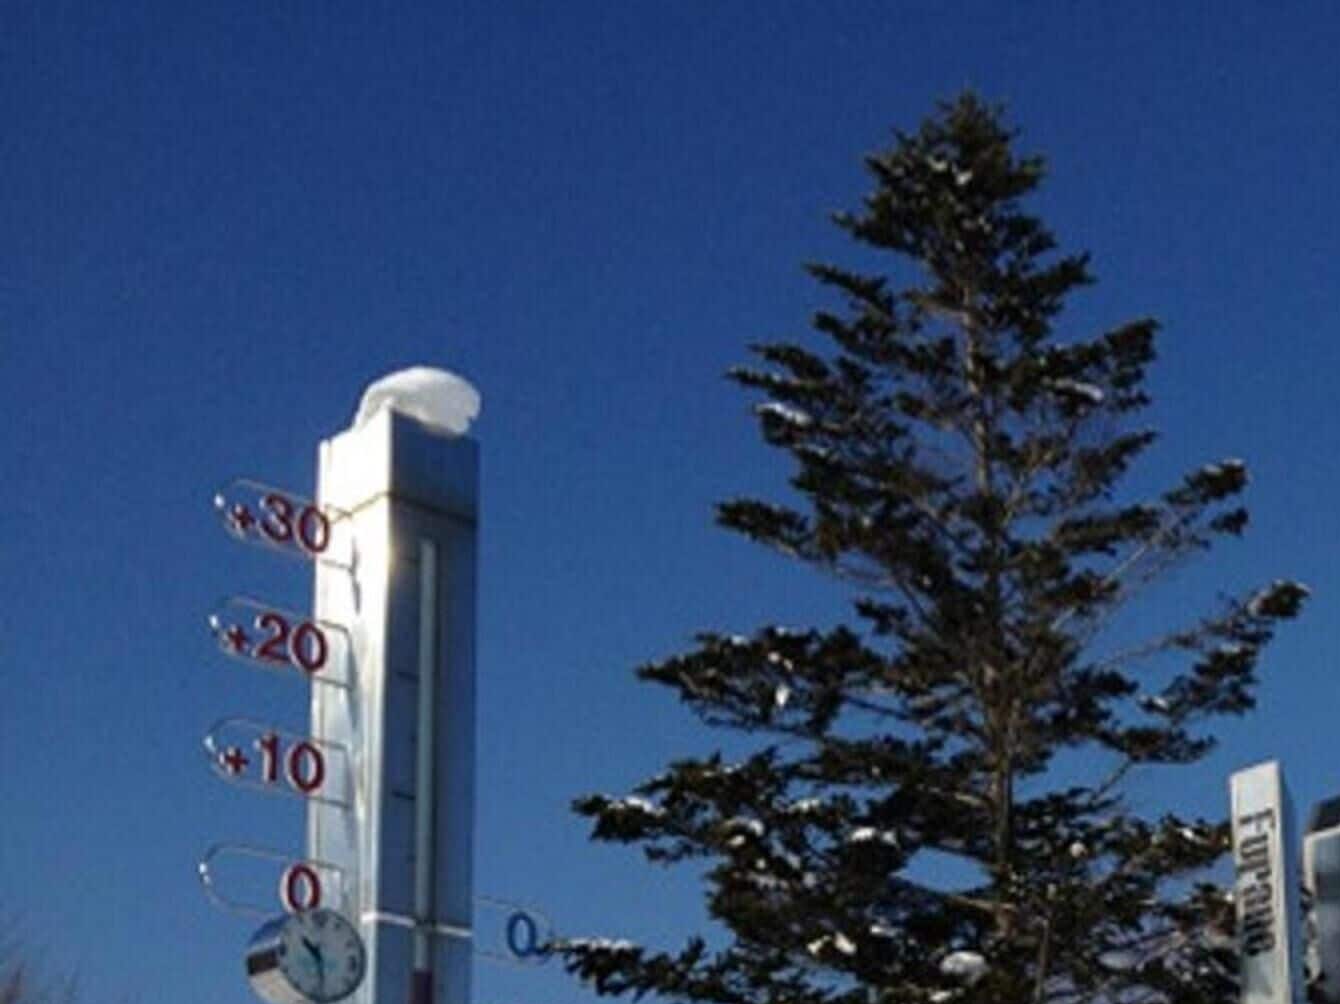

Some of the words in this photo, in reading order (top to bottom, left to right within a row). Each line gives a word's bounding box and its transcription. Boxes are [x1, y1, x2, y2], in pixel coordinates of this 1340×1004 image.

[230, 493, 331, 554] +30
[227, 612, 328, 673] +20
[224, 733, 325, 793] +10
[283, 863, 321, 912] 0
[506, 912, 540, 958] 0
